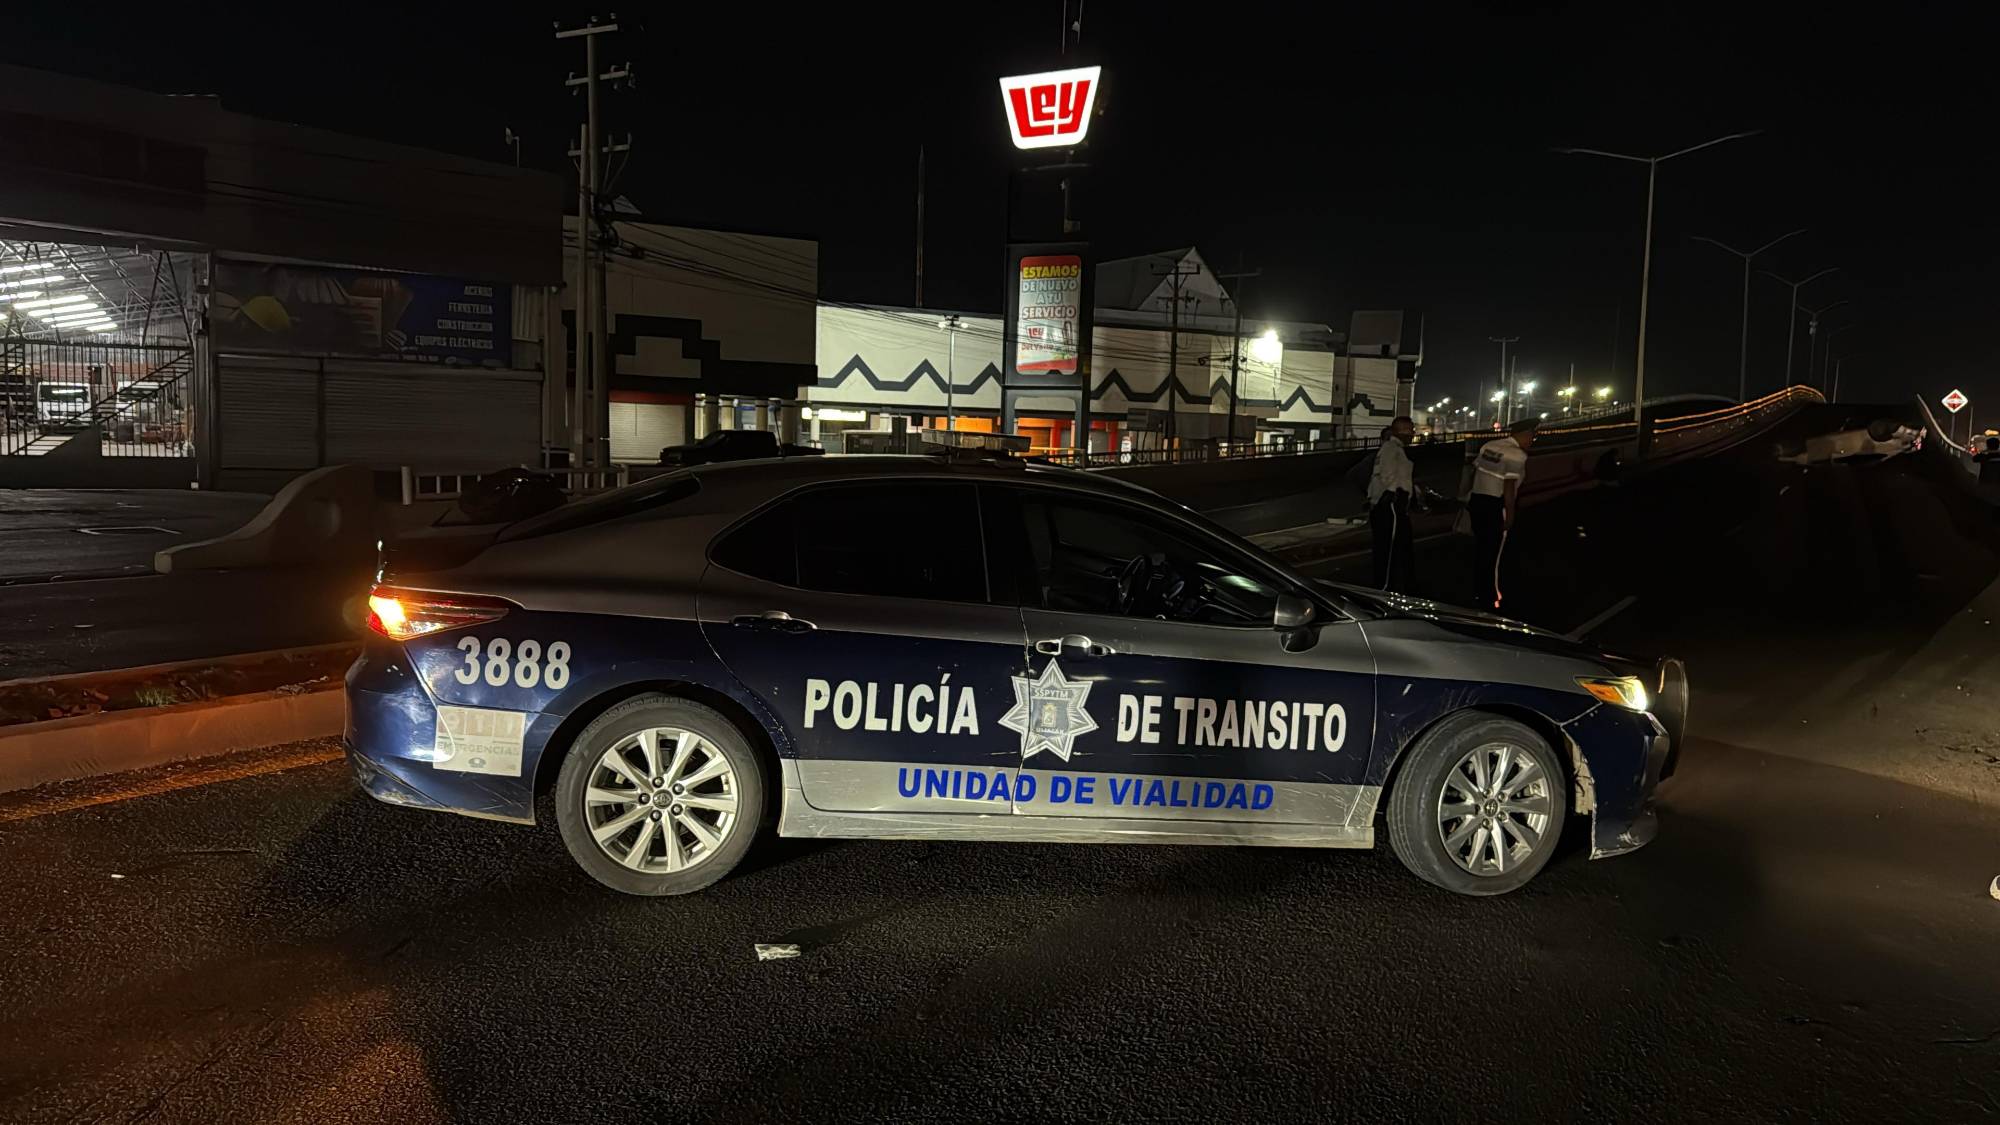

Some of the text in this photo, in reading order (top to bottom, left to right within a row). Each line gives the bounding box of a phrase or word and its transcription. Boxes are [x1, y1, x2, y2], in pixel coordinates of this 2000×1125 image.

[1022, 265, 1079, 279] ESTAMOS
[1022, 280, 1078, 293] DE NUEVO
[1036, 293, 1063, 304] A TU
[1022, 306, 1077, 320] SERVICIO
[454, 636, 571, 690] 3888
[803, 673, 1347, 753] POLICÍA DE TRANSITO
[898, 767, 1274, 810] UNIDAD DE VIALIDAD
